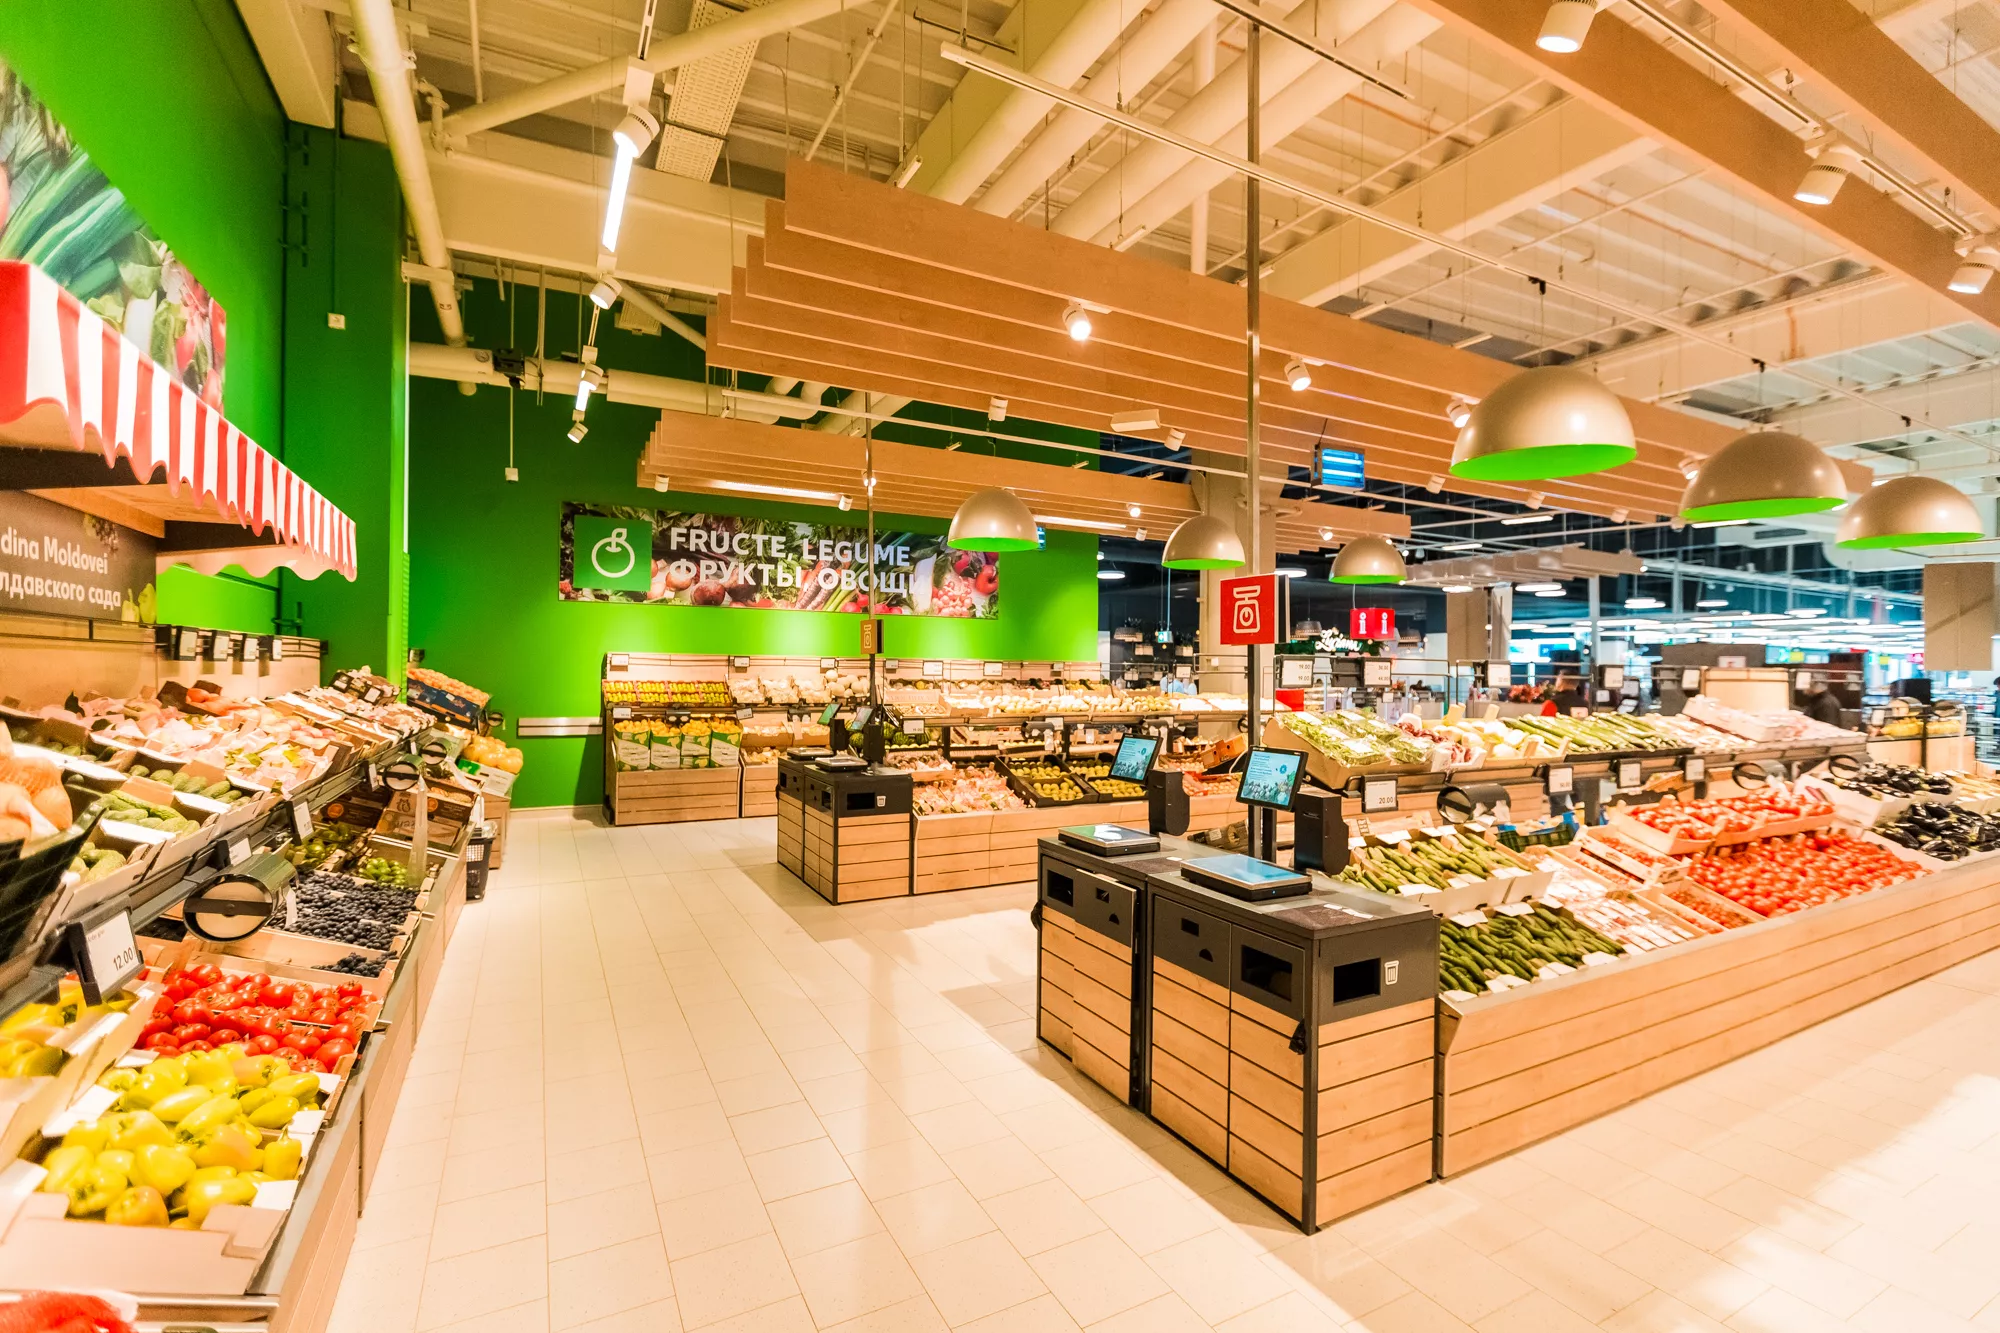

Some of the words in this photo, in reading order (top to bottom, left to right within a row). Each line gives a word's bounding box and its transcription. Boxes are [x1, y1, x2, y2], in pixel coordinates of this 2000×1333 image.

[44, 535, 109, 574] Moldovei
[670, 527, 794, 561] FRUCTE,
[803, 538, 911, 567] LEGUME
[88, 586, 121, 611] сада
[113, 947, 134, 971] 12.00
